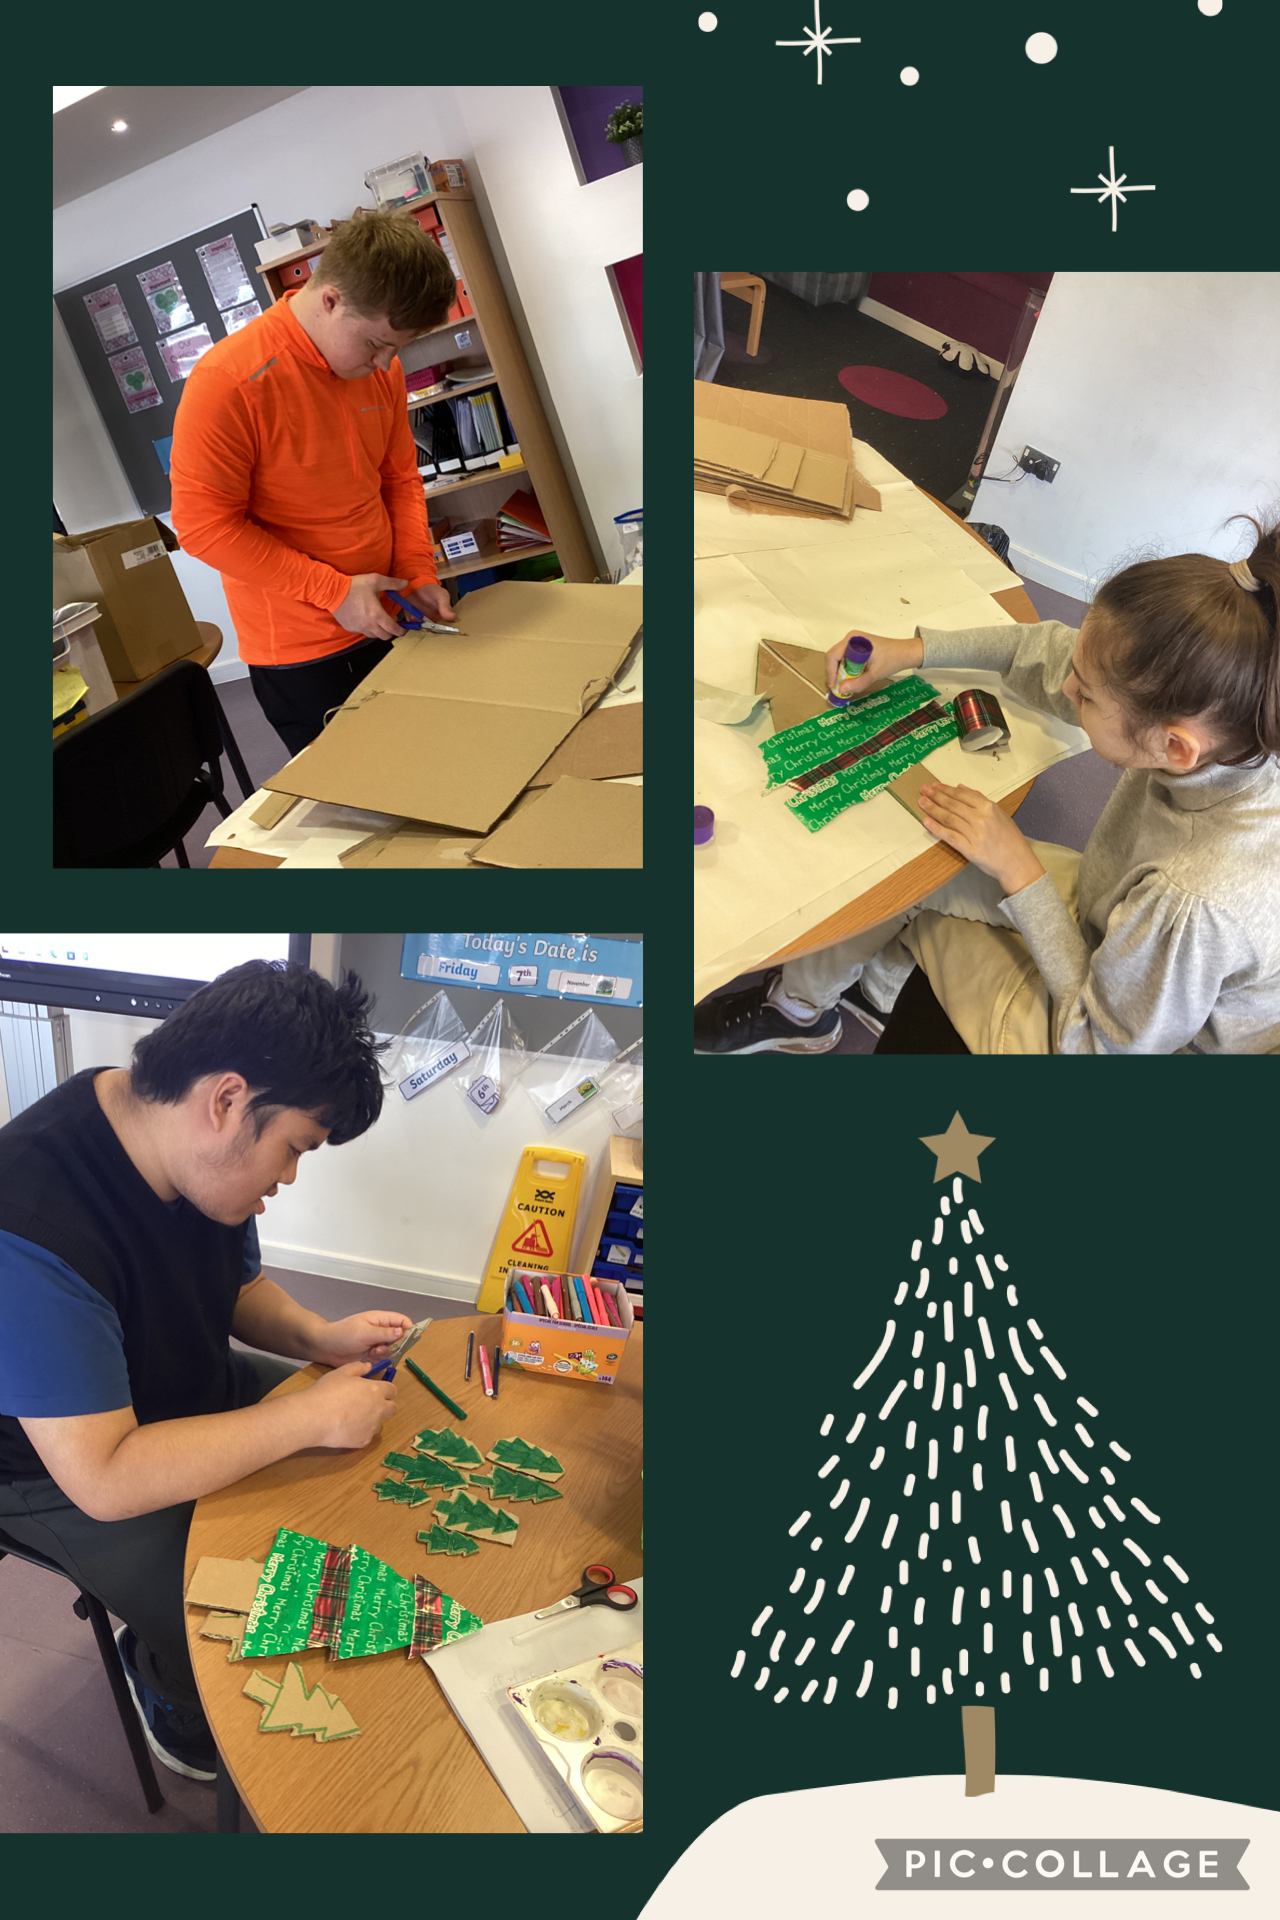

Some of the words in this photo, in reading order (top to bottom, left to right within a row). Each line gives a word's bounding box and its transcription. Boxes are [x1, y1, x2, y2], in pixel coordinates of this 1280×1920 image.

[766, 725, 815, 748] Christmas
[817, 712, 849, 727] Merry
[891, 684, 917, 697] Merry
[786, 739, 818, 754] Merry
[817, 719, 863, 741] Christmas
[866, 707, 893, 720] Merry
[892, 691, 929, 710] Christmas
[784, 745, 833, 771] Christmas
[836, 733, 867, 747] Merry
[787, 775, 839, 807] Christmas
[841, 760, 871, 778] Merry
[870, 738, 910, 761] Christmas
[911, 725, 939, 740] Merry
[808, 792, 843, 813] Merry
[840, 767, 887, 794] Christmas
[888, 752, 916, 768] Merry
[913, 731, 952, 753] Christmas
[463, 933, 527, 958] Today's
[533, 940, 577, 961] Date
[580, 943, 599, 963] is
[438, 961, 479, 980] Friday
[515, 968, 532, 982] 7th
[566, 979, 591, 988] November
[409, 1051, 459, 1090] Saturday
[477, 1082, 490, 1100] 6th
[558, 1099, 573, 1112] March
[517, 1202, 566, 1218] CAUTION
[498, 1266, 509, 1274] IN
[507, 1259, 550, 1271] CLEANING
[261, 1552, 285, 1583] Merry
[280, 1548, 306, 1591] Christmas
[307, 1551, 326, 1579] Merry
[357, 1551, 371, 1572] erry
[245, 1583, 276, 1634] Christmas
[264, 1597, 287, 1630] Merry
[297, 1583, 320, 1630] Christmas
[350, 1575, 372, 1622] Christmas
[368, 1588, 387, 1619] Merry
[398, 1593, 414, 1642] Christmas
[365, 1621, 384, 1655] Christ
